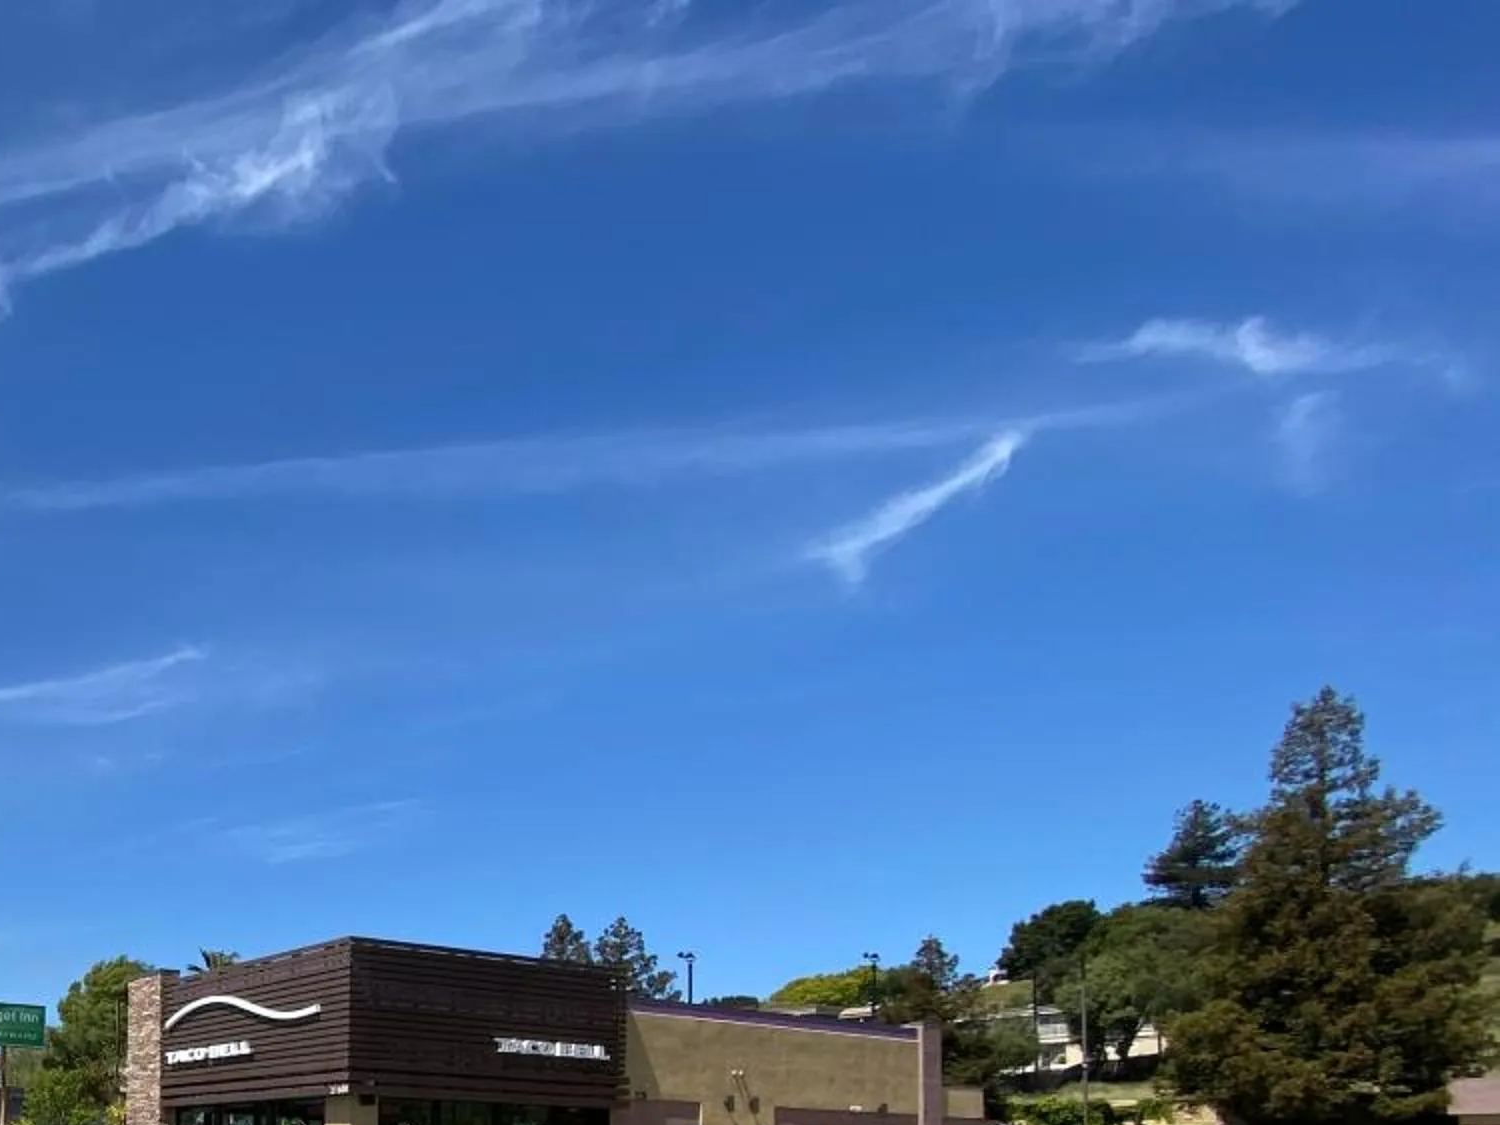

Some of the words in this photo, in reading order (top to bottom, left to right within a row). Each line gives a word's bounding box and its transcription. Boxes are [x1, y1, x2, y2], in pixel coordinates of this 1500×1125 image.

[165, 1046, 206, 1065] TACO
[208, 1041, 254, 1059] BELL
[493, 1037, 554, 1056] TACO
[555, 1042, 611, 1060] BELL
